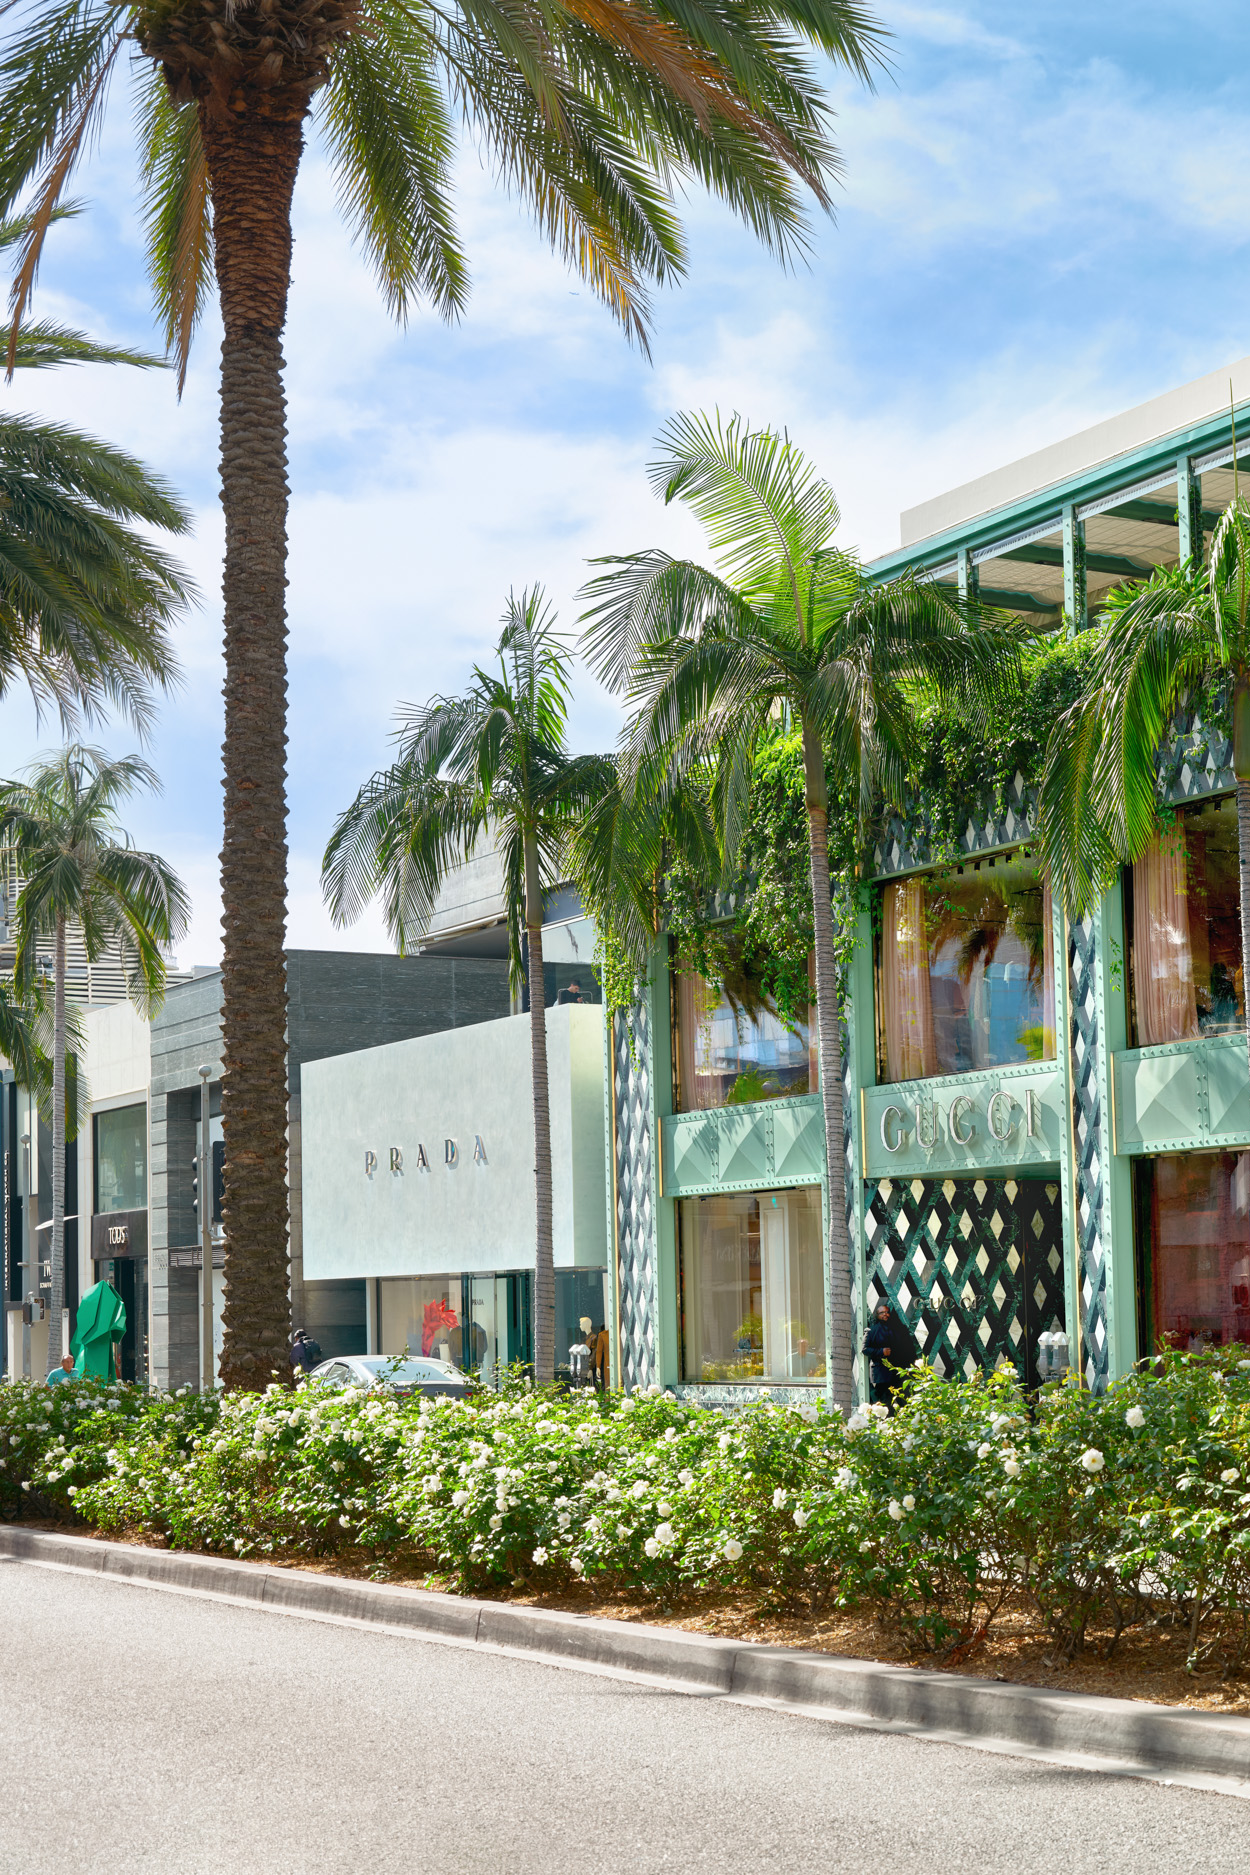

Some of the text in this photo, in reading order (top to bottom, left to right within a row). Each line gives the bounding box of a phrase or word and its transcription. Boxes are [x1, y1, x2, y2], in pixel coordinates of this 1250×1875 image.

[880, 1089, 1036, 1152] GUCCI
[364, 1134, 488, 1175] PRADA
[913, 1296, 978, 1310] GUCCI
